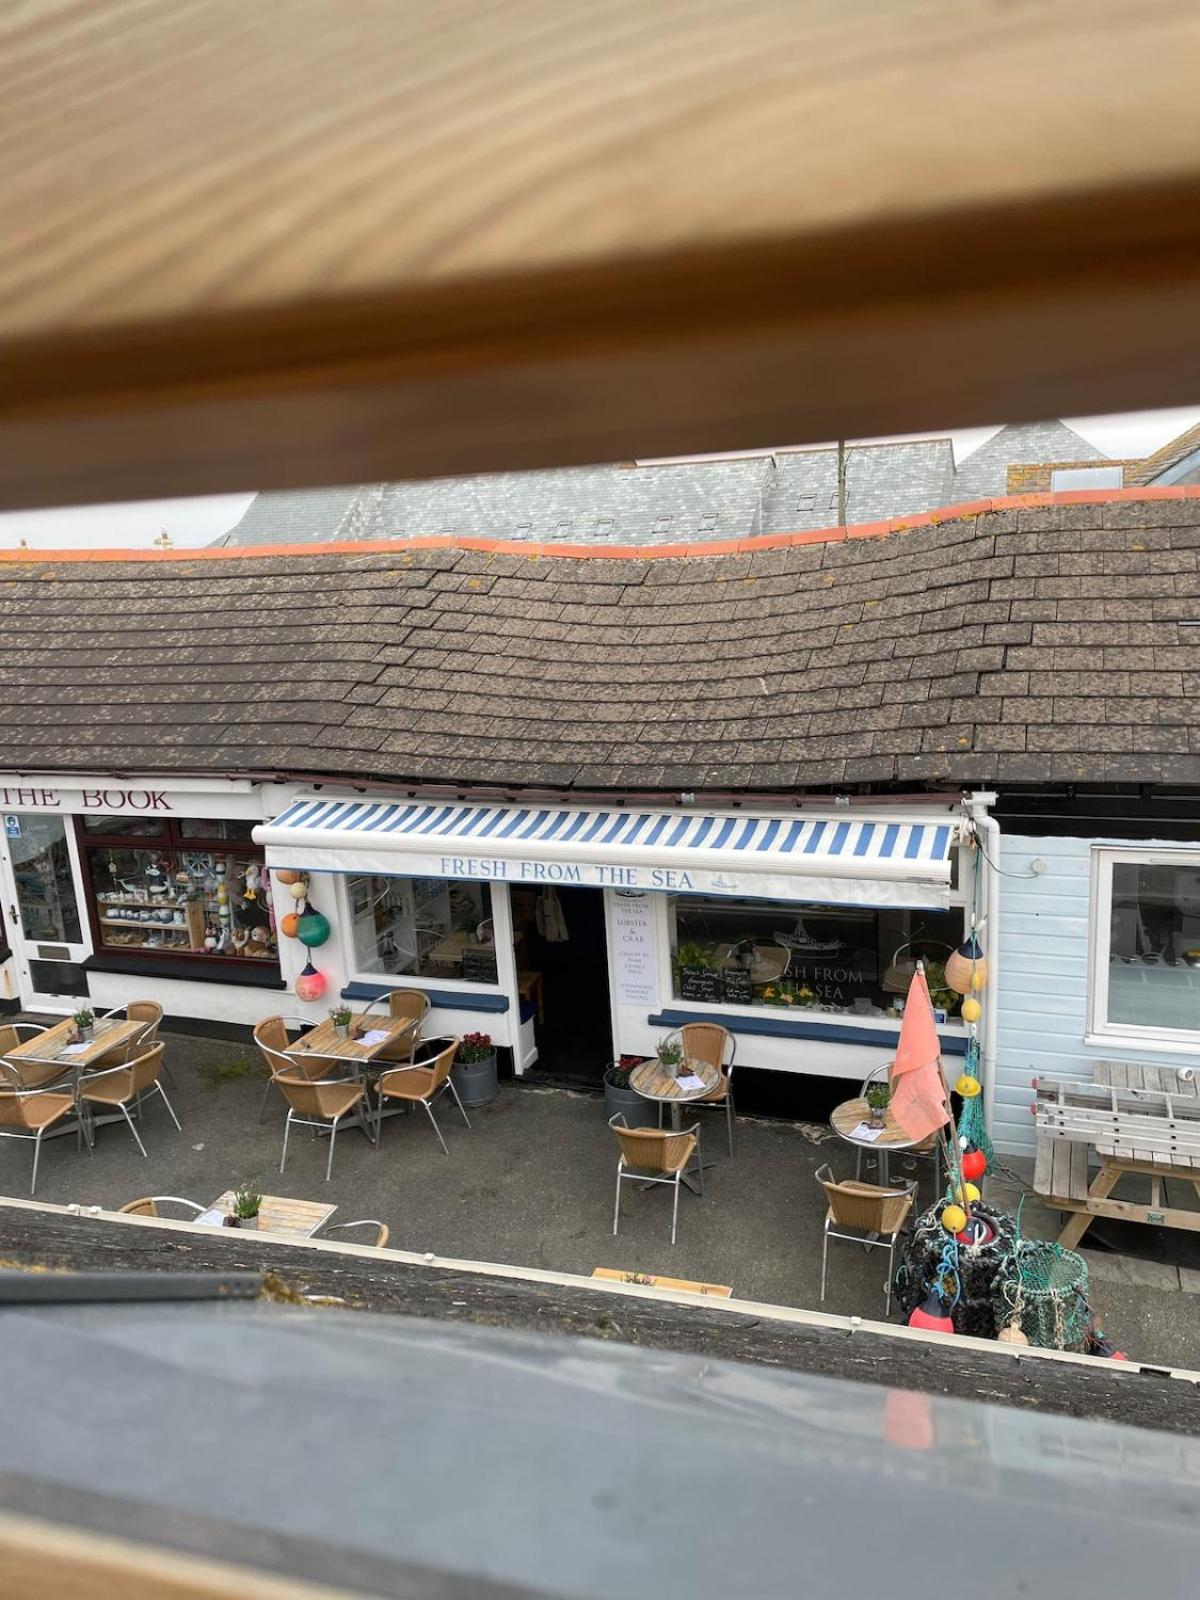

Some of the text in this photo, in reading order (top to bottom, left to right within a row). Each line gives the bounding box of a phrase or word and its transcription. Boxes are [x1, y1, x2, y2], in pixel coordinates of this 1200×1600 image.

[1, 788, 173, 811] THE BOOK
[440, 857, 694, 890] FRESH FROM THE SEA
[617, 918, 648, 927] LOBSTER
[622, 935, 645, 943] CRAB
[814, 967, 863, 984] FROM
[815, 984, 844, 999] SEA
